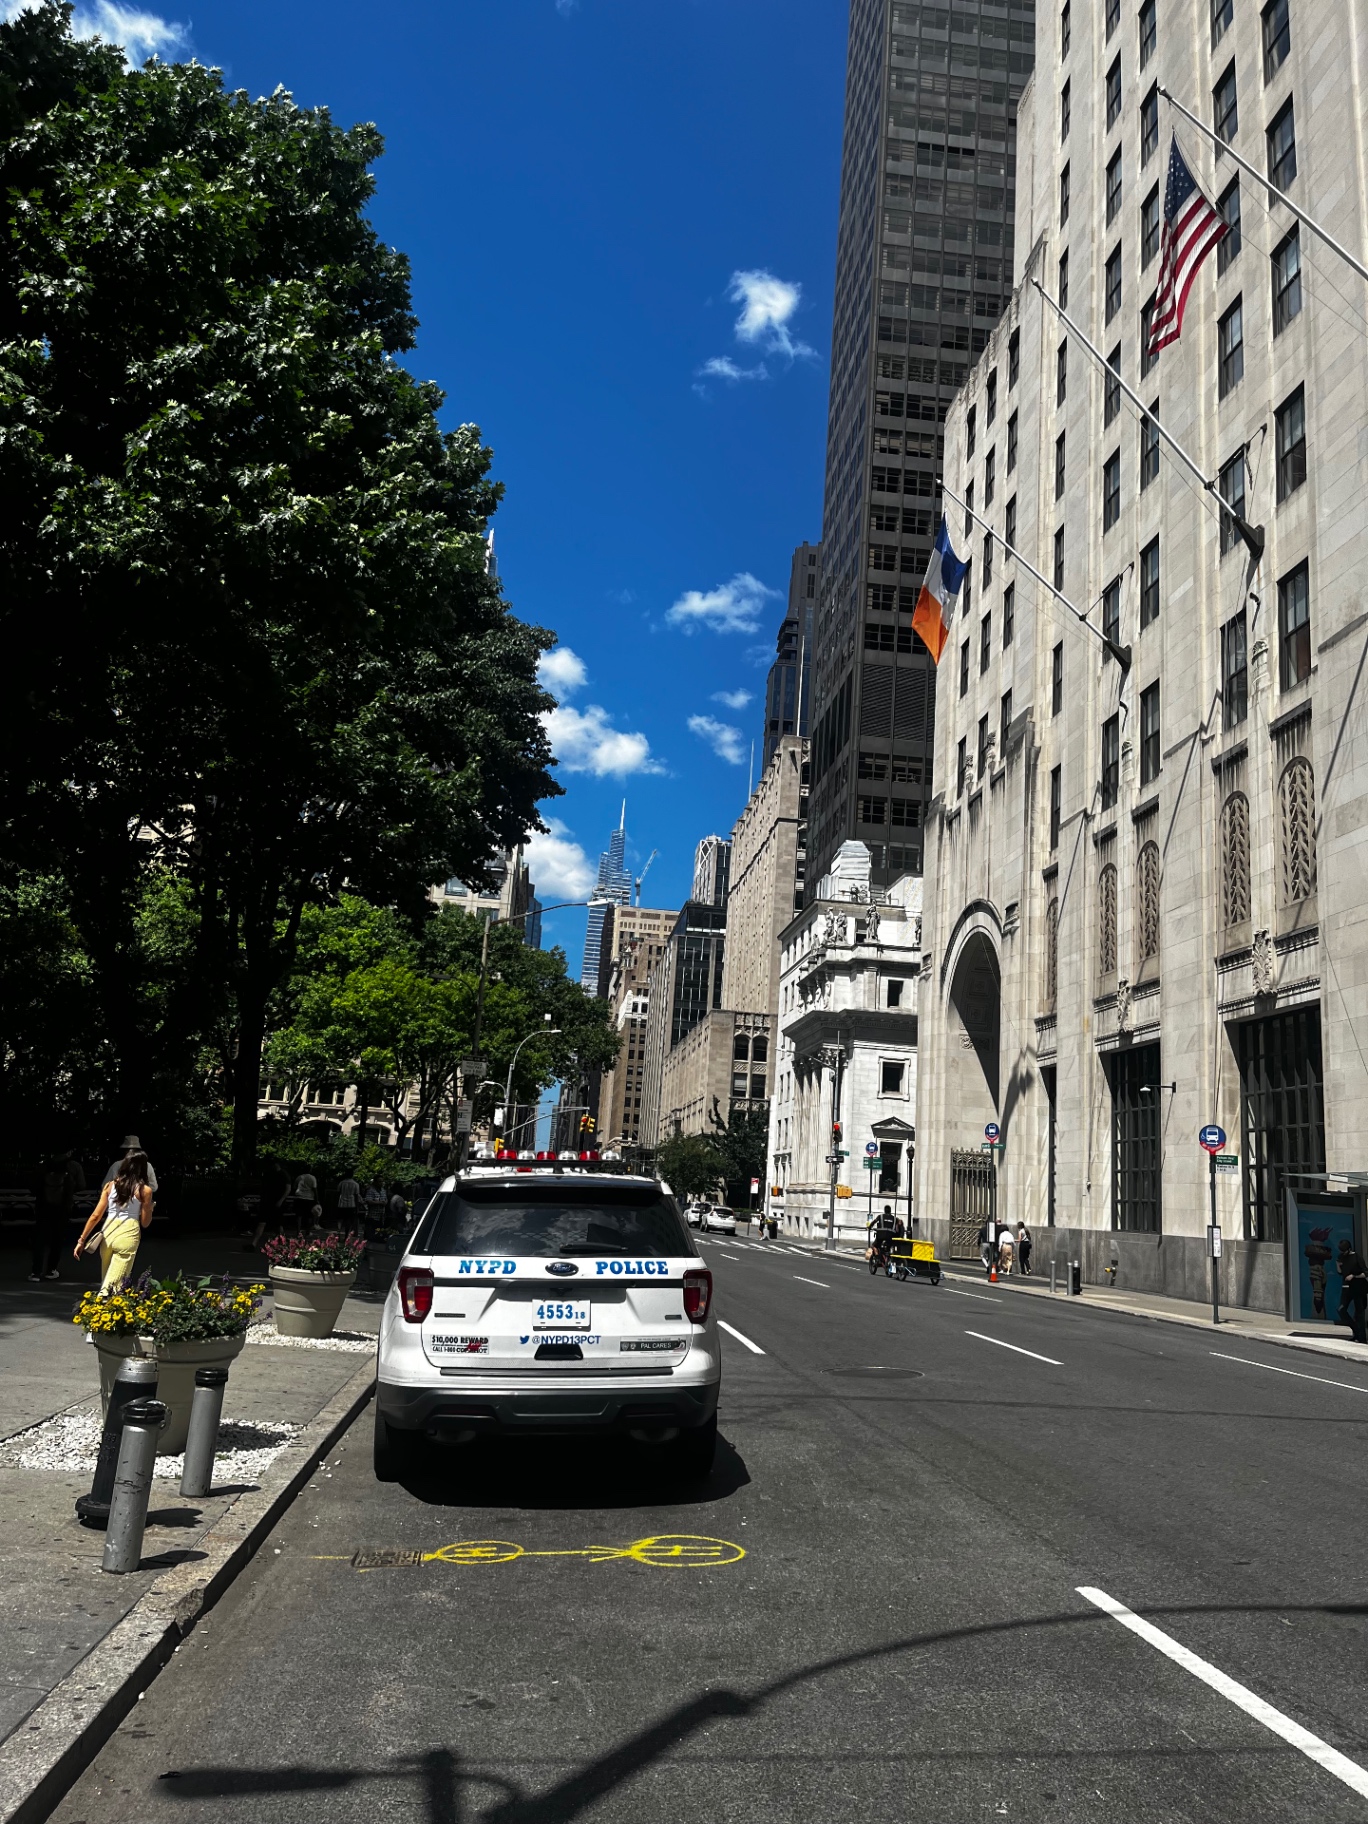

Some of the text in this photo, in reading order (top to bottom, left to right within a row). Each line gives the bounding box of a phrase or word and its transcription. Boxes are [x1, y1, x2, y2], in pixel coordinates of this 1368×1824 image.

[458, 1260, 517, 1275] NYPD
[595, 1260, 669, 1275] POLICE
[536, 1304, 586, 1320] 4553 18
[431, 1335, 489, 1345] $10,000 REWARD
[531, 1335, 602, 1345] @NYPD13PCT
